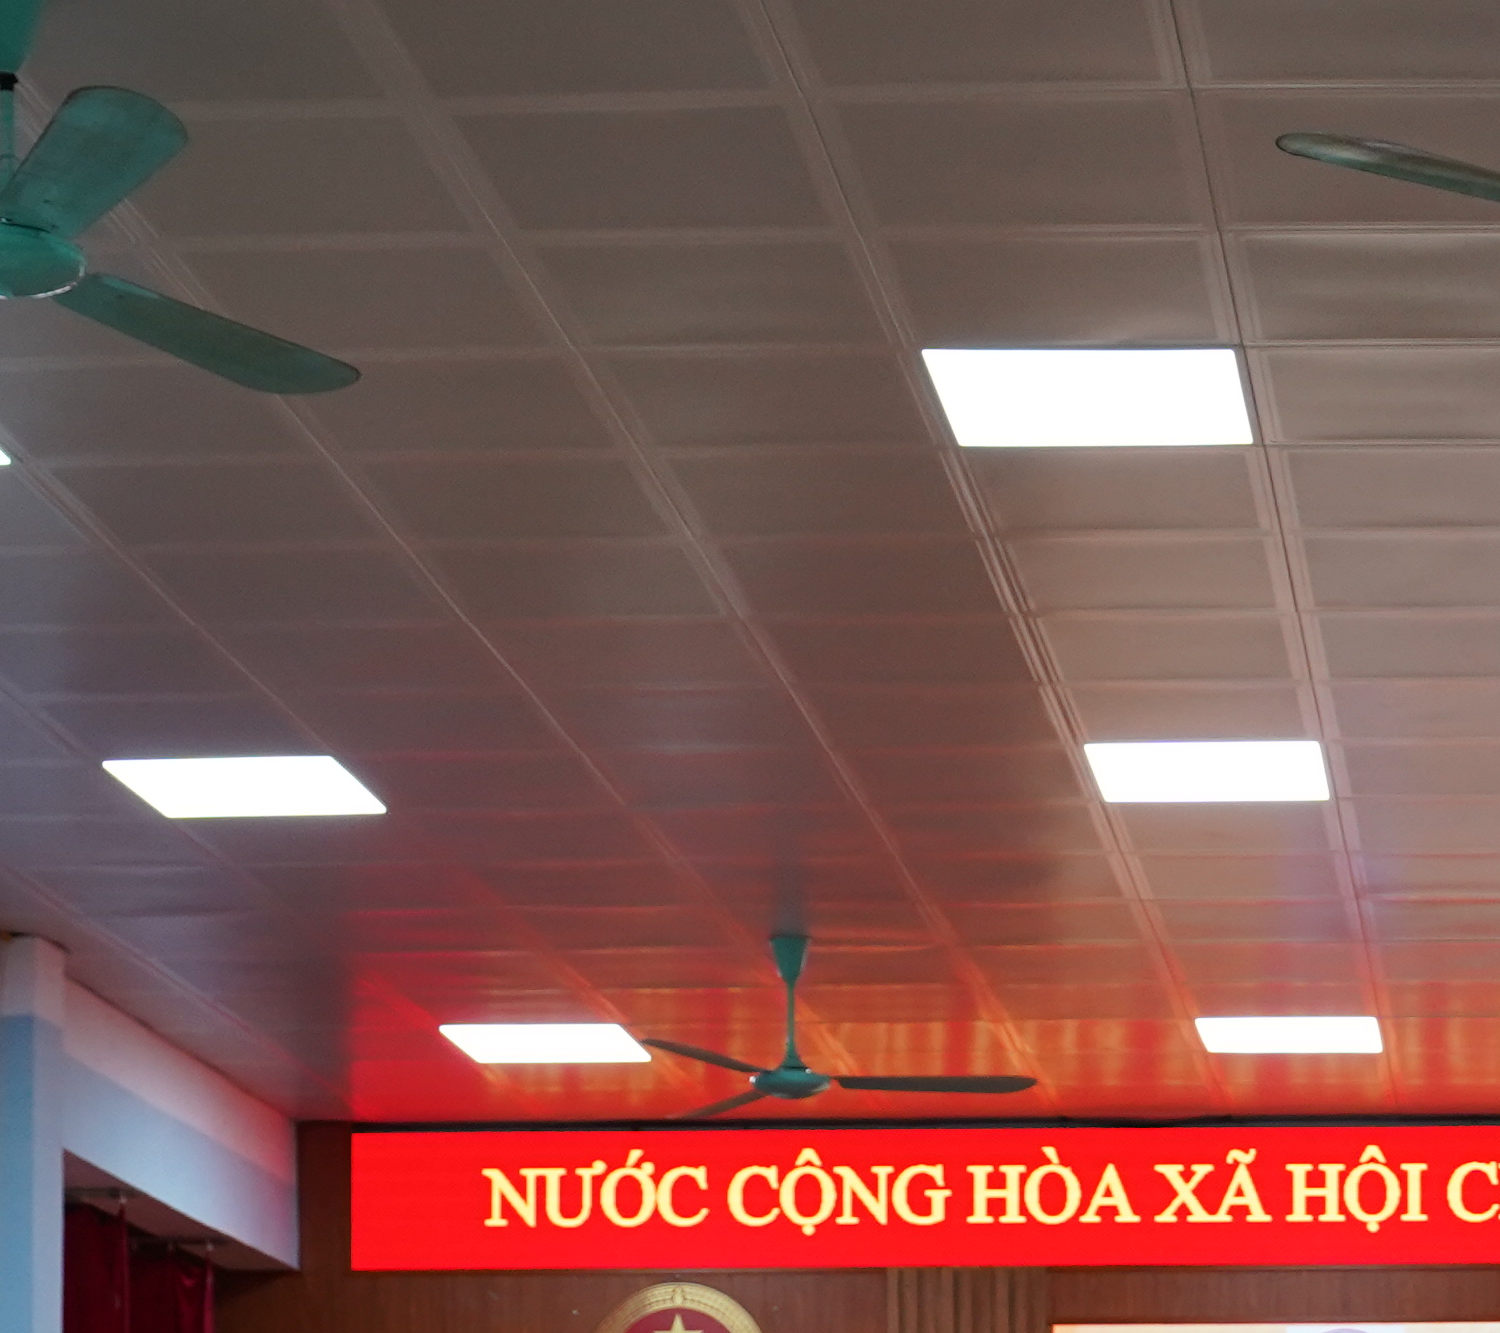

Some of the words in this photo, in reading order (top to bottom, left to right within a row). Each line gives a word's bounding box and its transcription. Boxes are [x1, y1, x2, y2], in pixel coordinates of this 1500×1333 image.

[482, 1149, 709, 1227] NƯỚC
[728, 1148, 952, 1235] CỘNG
[967, 1147, 1141, 1224] HÒA
[1154, 1149, 1272, 1222] XÃ
[1286, 1145, 1428, 1232] HỘI
